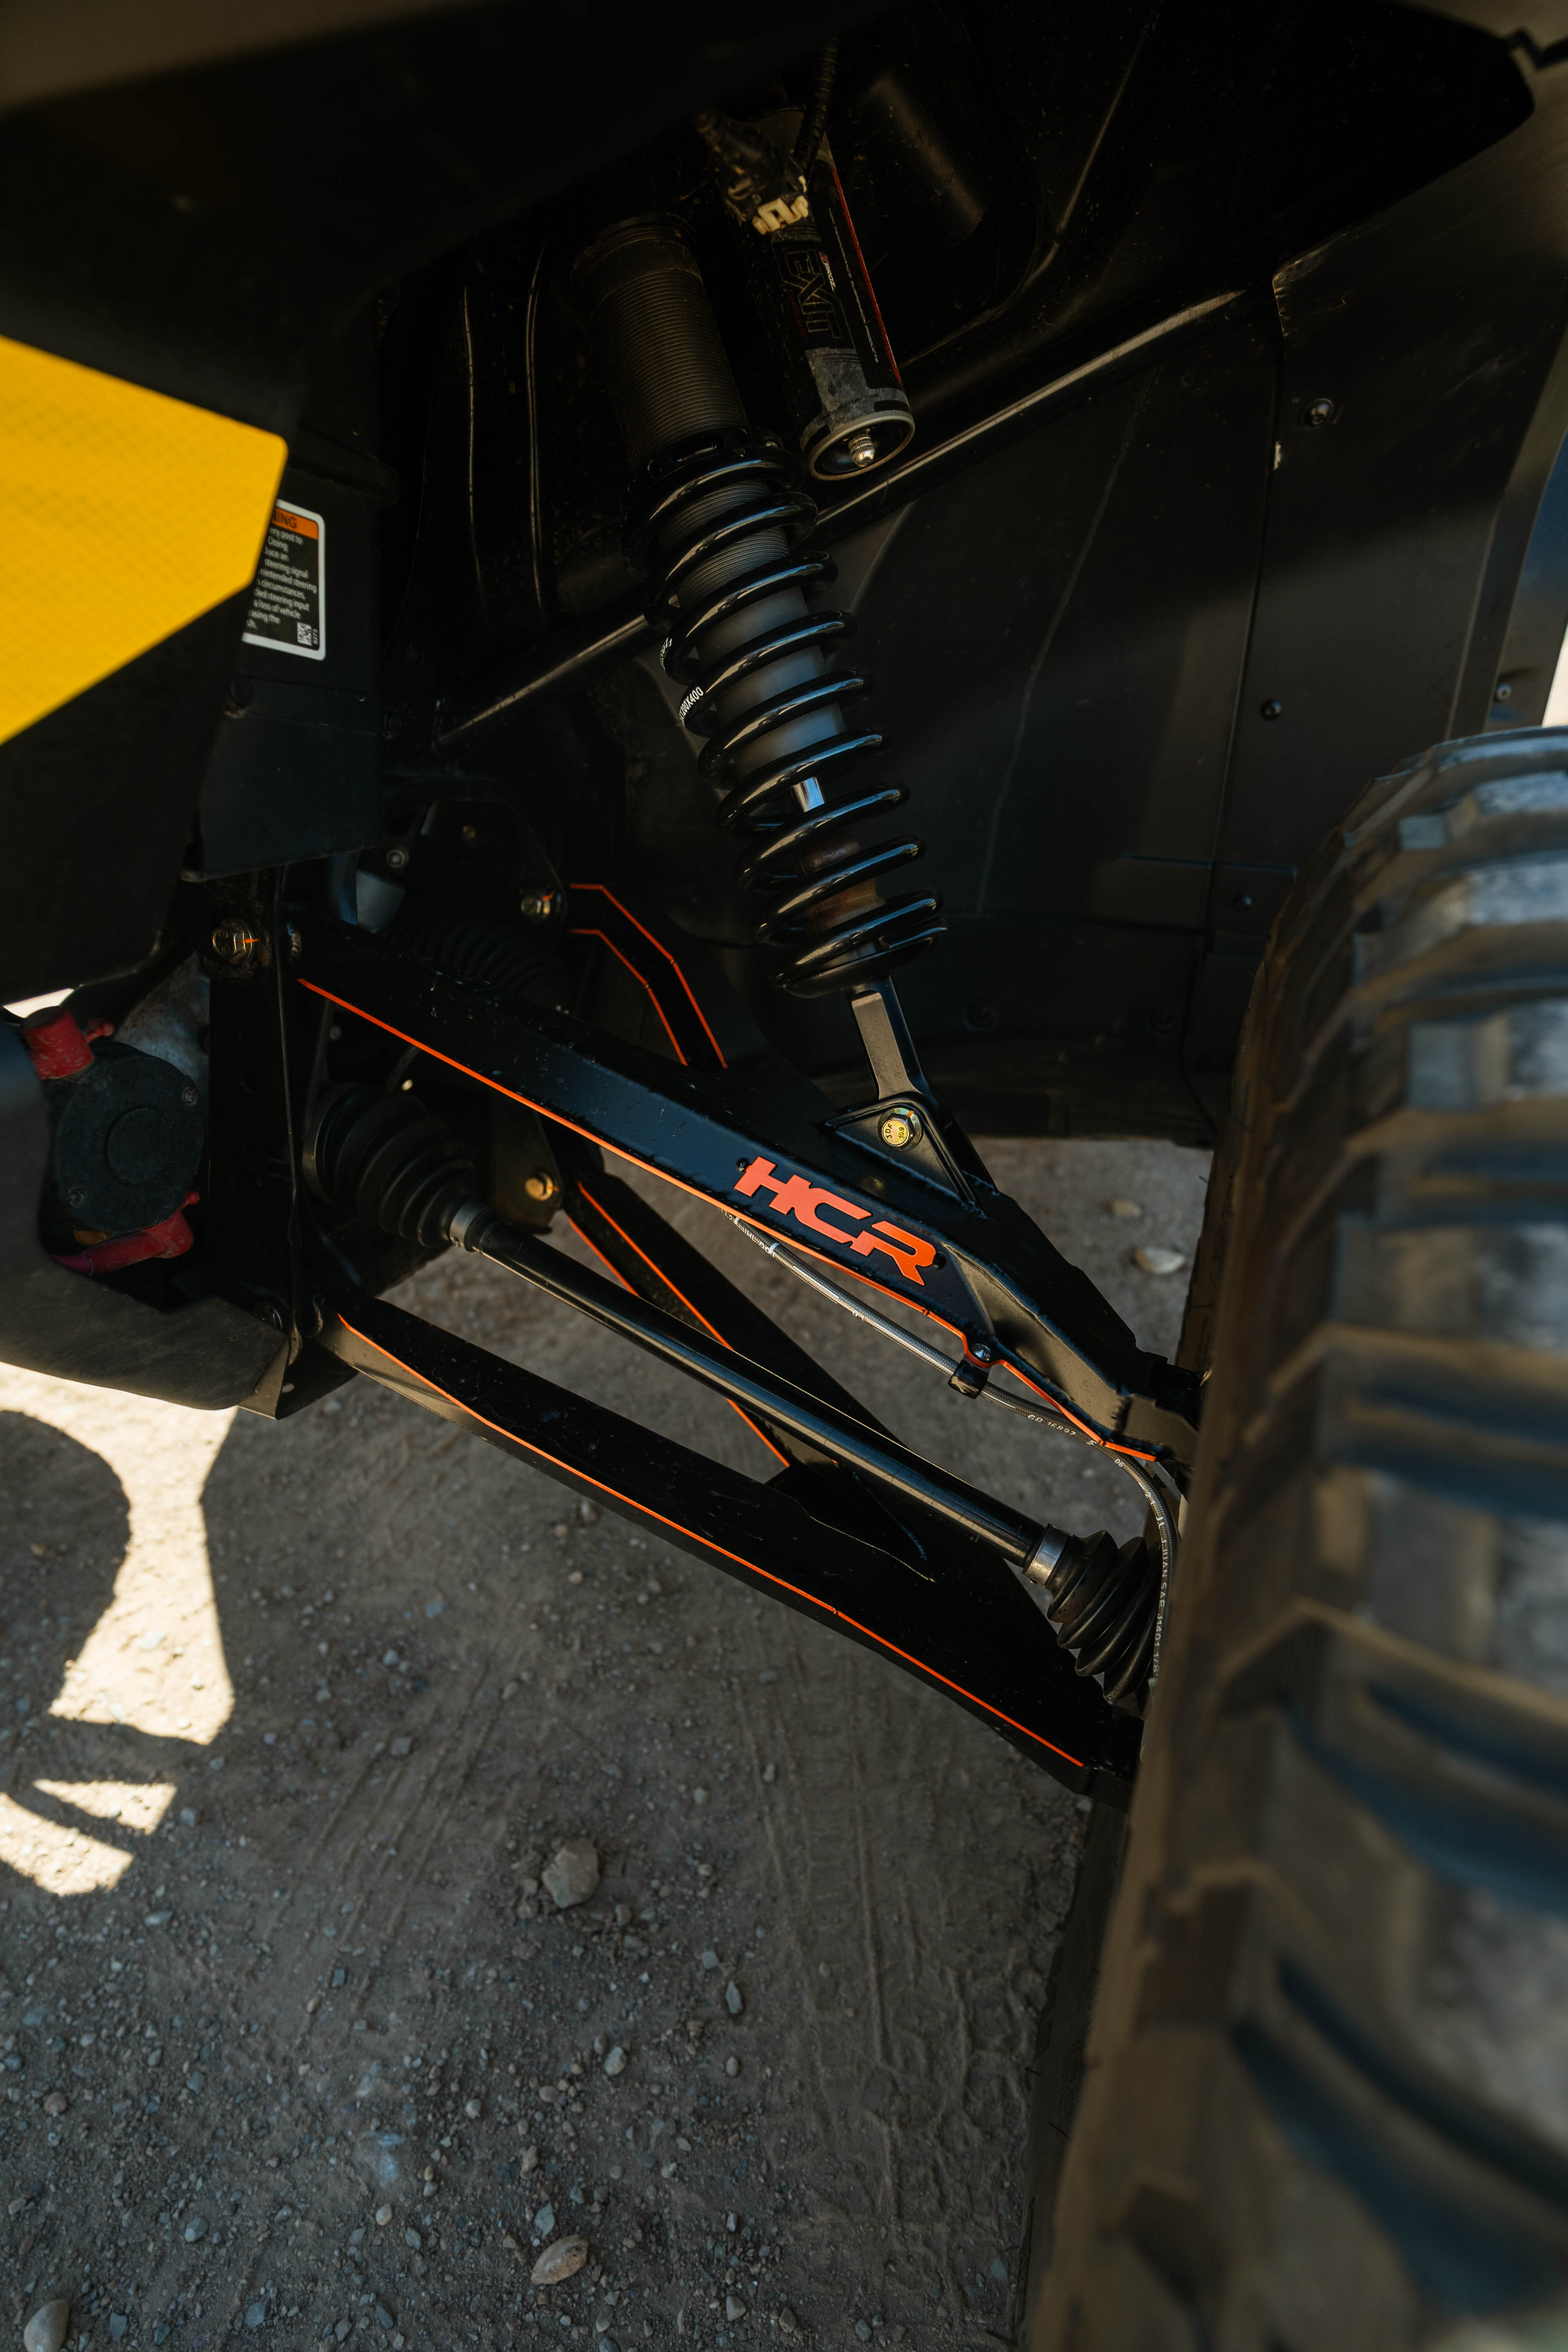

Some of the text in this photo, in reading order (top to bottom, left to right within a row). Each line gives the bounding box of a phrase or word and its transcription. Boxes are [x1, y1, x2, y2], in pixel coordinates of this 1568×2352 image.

[819, 251, 837, 292] ZBROZ
[865, 325, 878, 363] PRODUCTS
[268, 536, 289, 553] Doing
[281, 531, 294, 542] post
[295, 535, 304, 545] to
[264, 559, 309, 579] steering signal
[294, 579, 317, 595] steering
[258, 599, 271, 612] loss
[272, 604, 279, 613] of
[279, 607, 301, 620] vehicle
[268, 593, 294, 608] steering
[269, 613, 281, 625] the
[734, 1156, 936, 1285] HCR
[1047, 1421, 1076, 1435] 16897
[1114, 1458, 1124, 1467] 06
